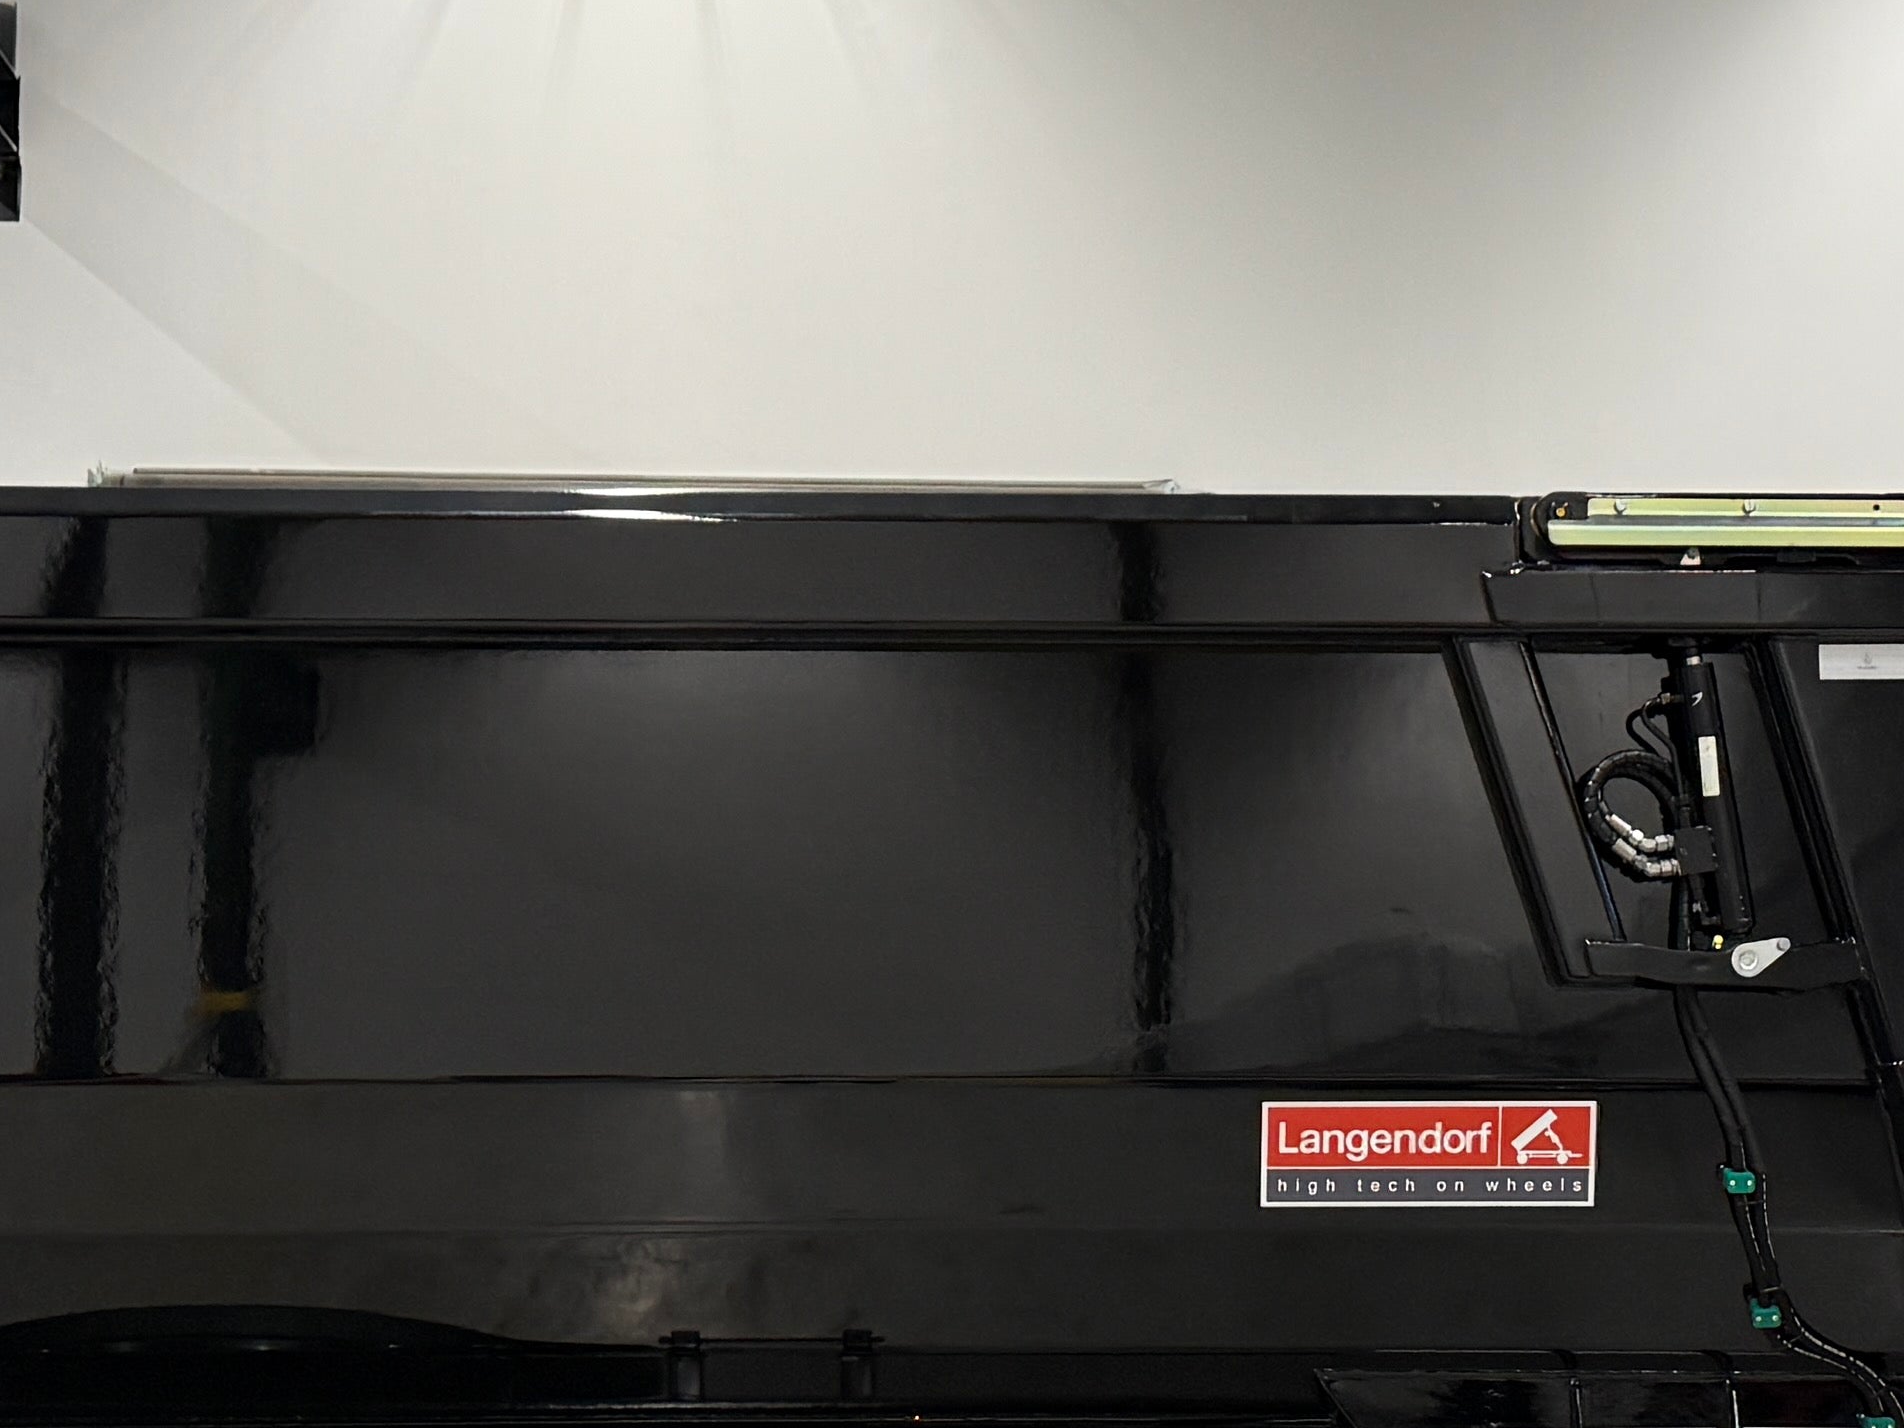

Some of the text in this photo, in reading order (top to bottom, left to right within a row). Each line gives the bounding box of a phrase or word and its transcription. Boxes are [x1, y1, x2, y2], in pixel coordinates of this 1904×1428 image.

[1278, 1121, 1492, 1162] Langendorf
[1277, 1177, 1583, 1195] high tech on wheels
